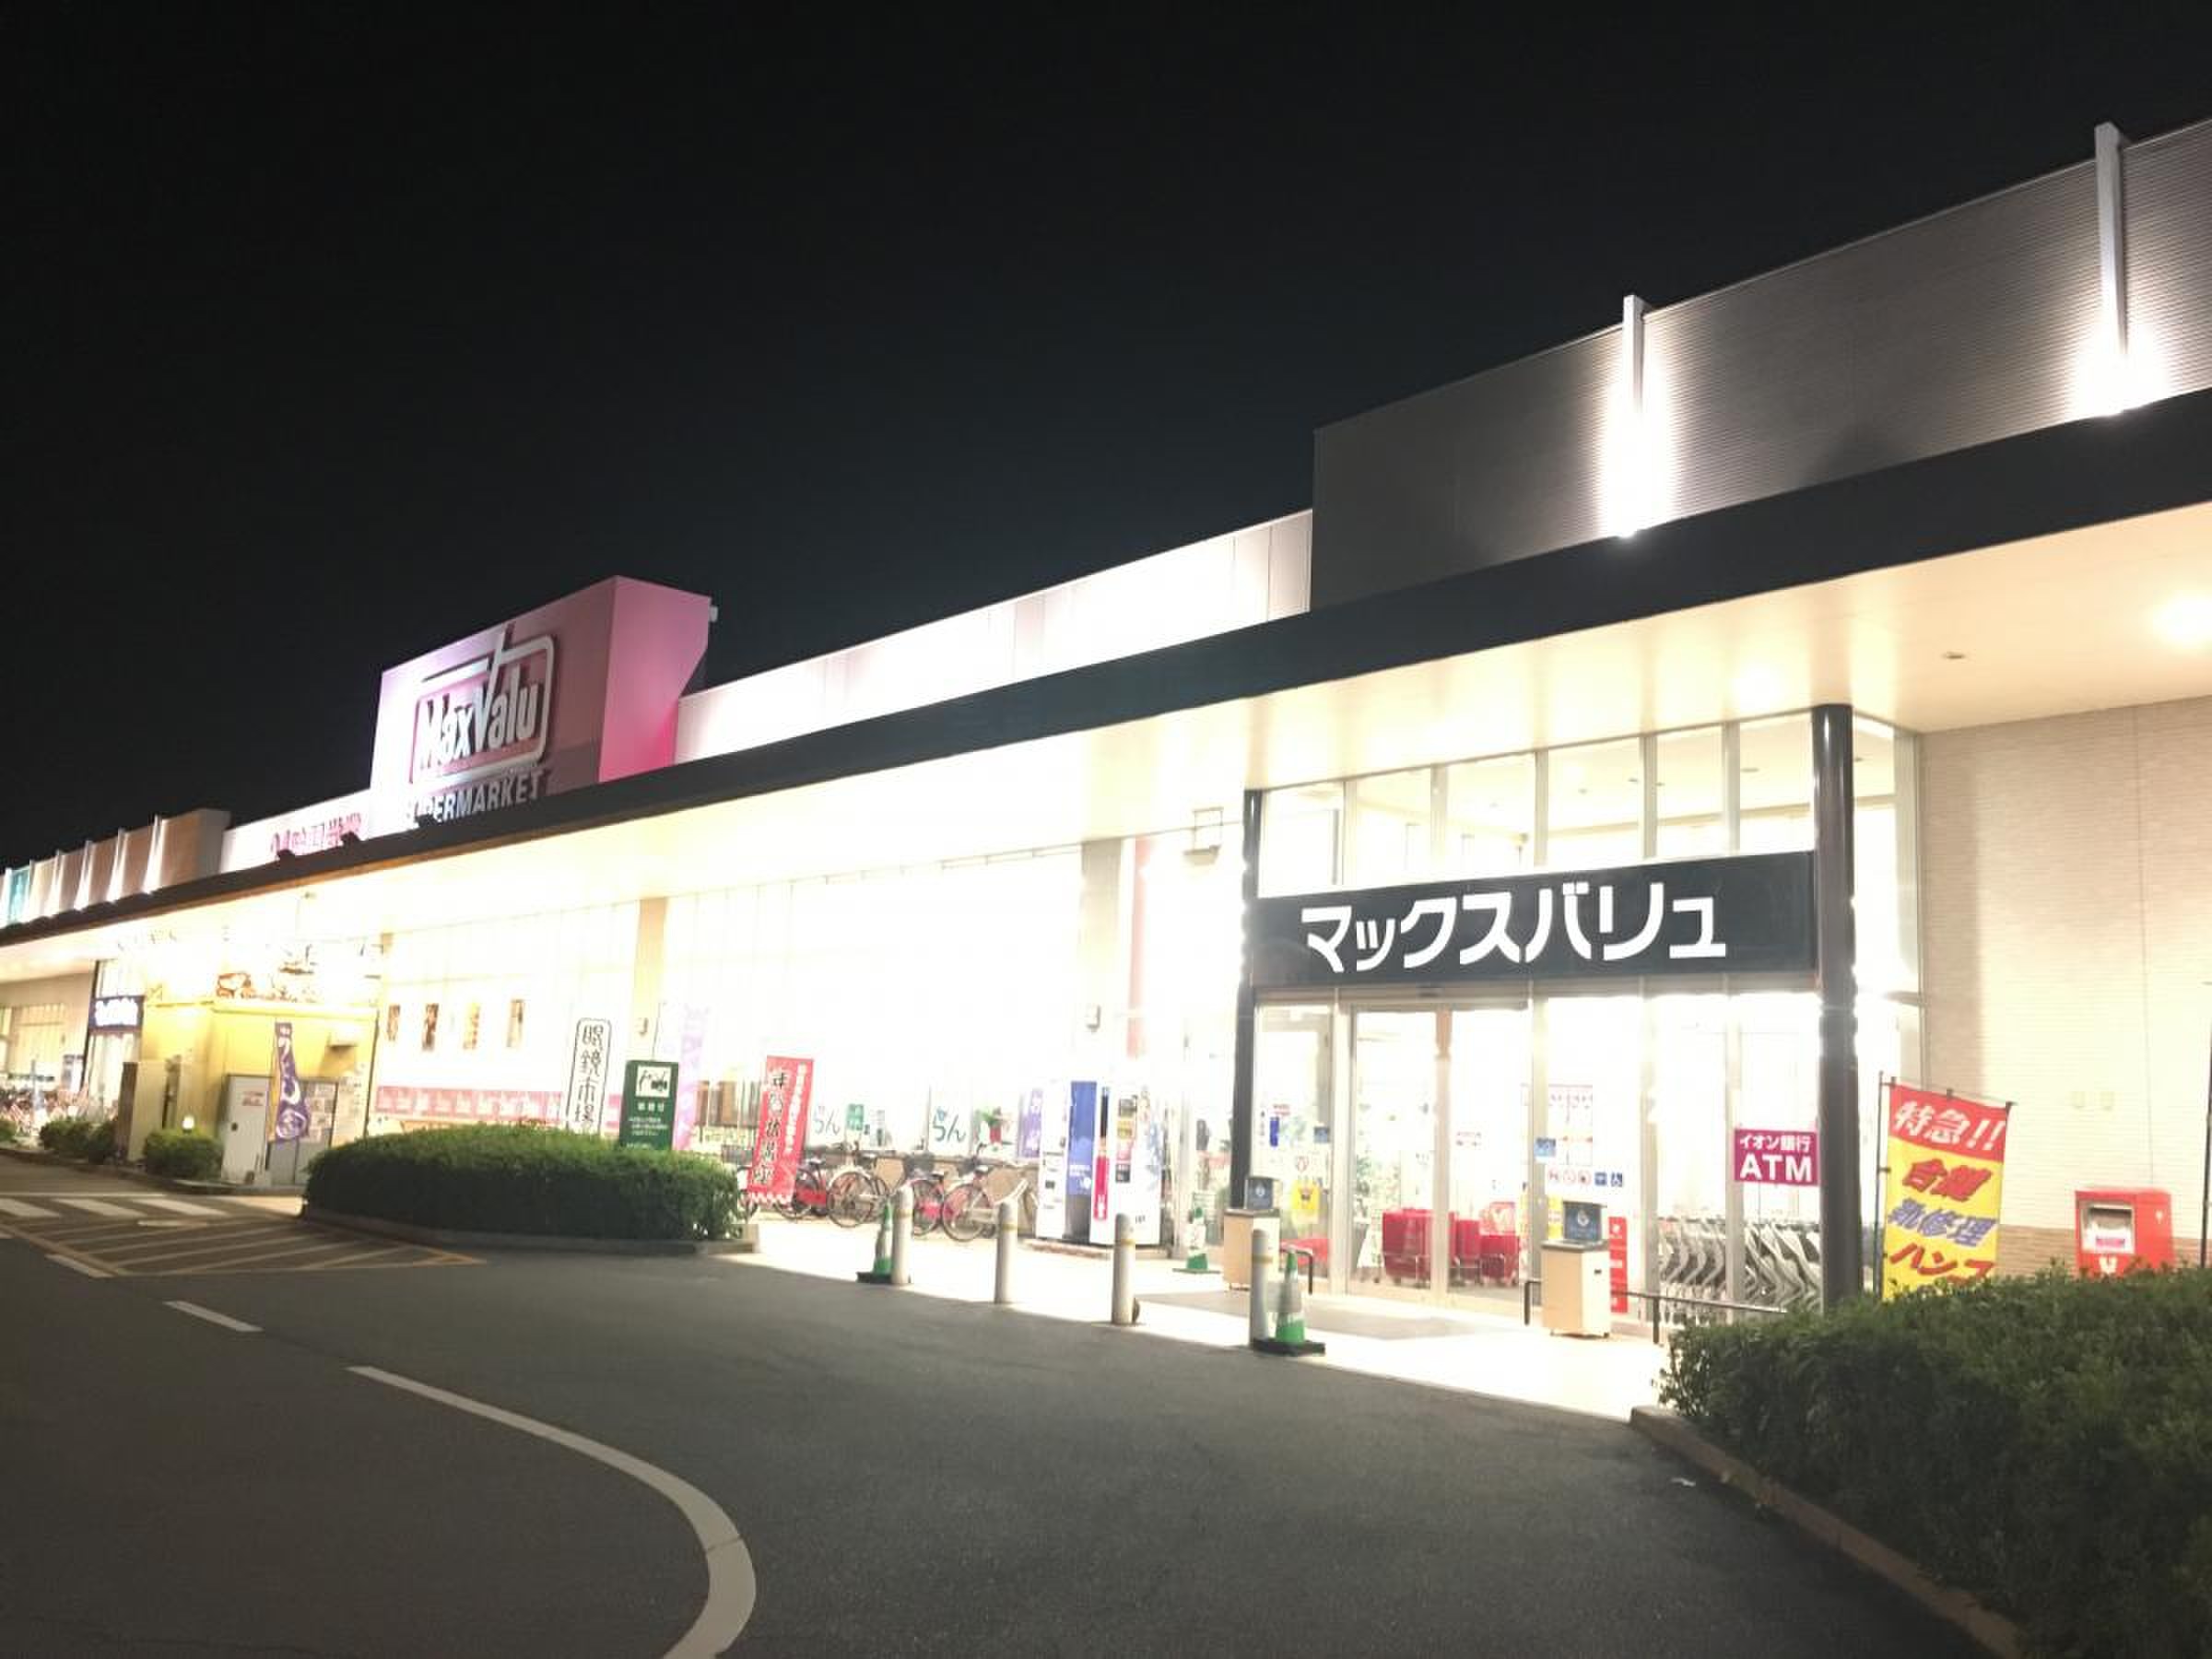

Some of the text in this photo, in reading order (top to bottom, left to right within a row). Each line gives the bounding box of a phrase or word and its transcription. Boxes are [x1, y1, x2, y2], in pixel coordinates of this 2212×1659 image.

[419, 627, 539, 770] MaxValu
[402, 771, 542, 824] PERMARKET
[1301, 882, 1727, 973] マックスバリュ
[1739, 1133, 1811, 1153] イオン銀行
[1740, 1153, 1813, 1182] ATM
